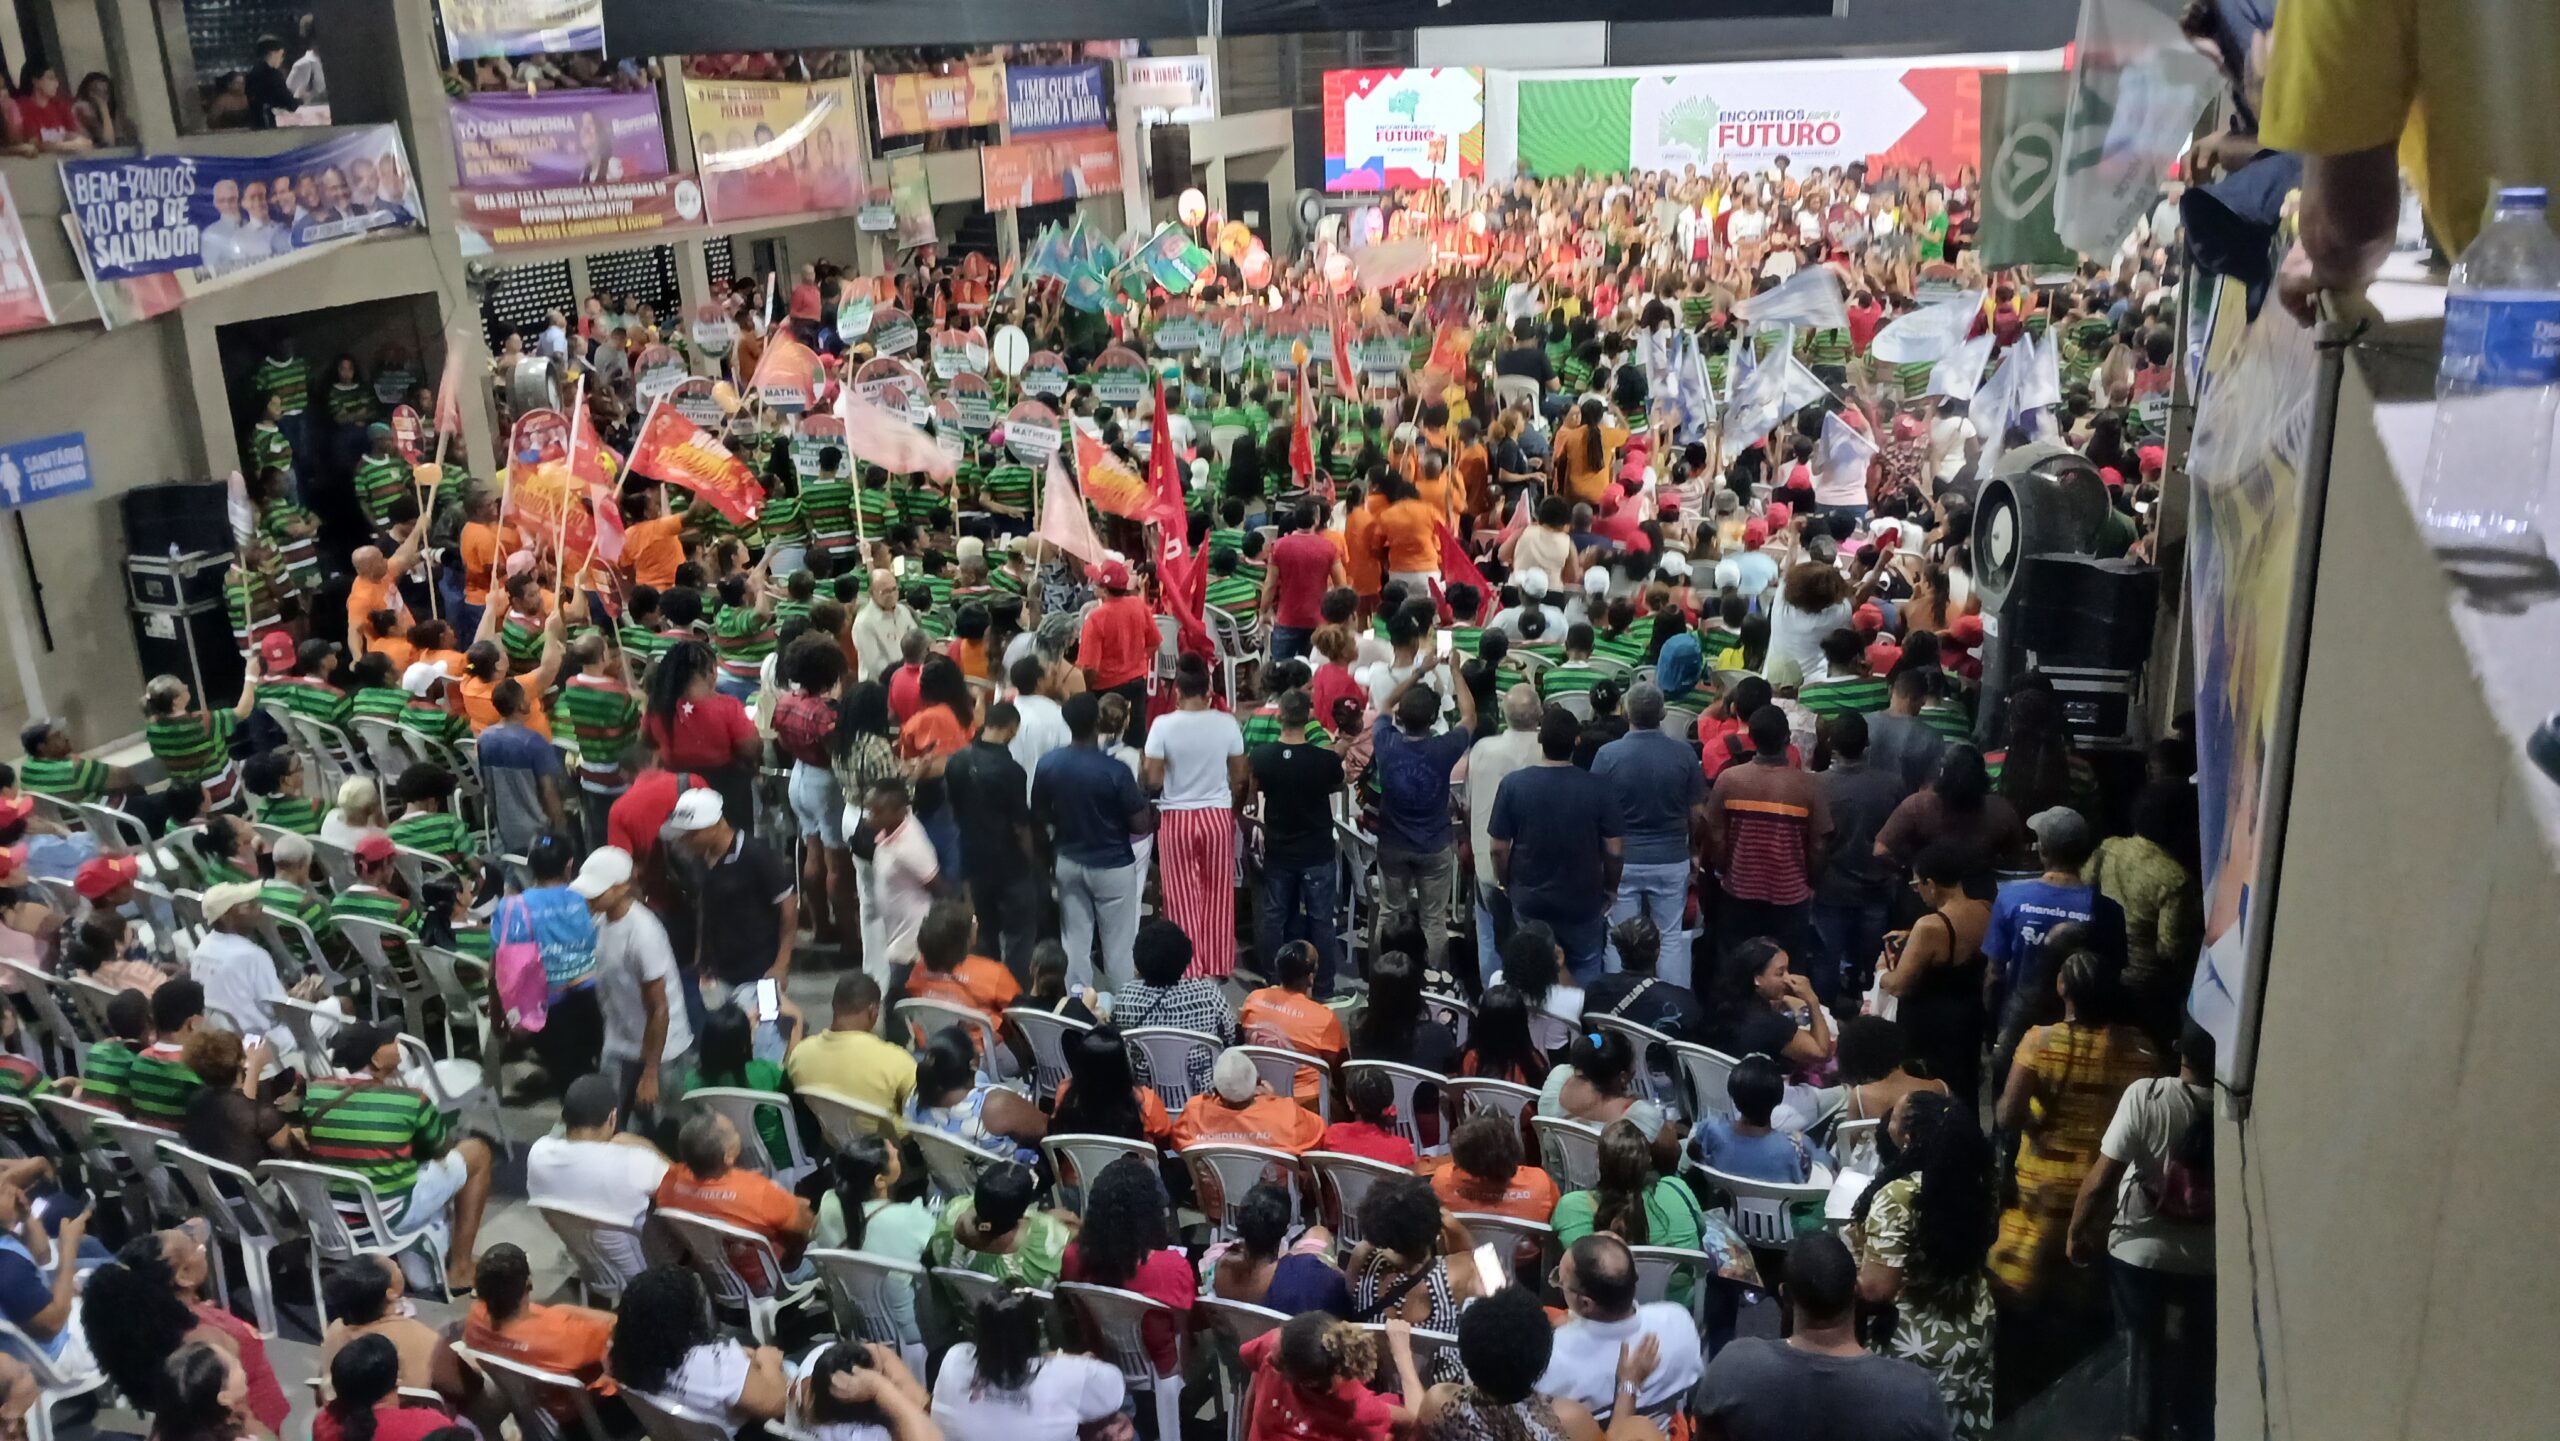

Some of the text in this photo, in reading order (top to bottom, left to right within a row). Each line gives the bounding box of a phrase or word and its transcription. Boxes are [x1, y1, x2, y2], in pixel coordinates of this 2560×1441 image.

[1017, 78, 1046, 101] TIME
[1049, 76, 1073, 100] QUE
[1011, 95, 1100, 128] MUDANDO A BAHIA
[1719, 109, 1805, 122] ENCONTROS
[479, 119, 511, 138] COM
[1376, 130, 1435, 142] FUTURO
[1719, 121, 1842, 149] FUTURO
[75, 165, 196, 205] BEM-VINDOS
[86, 197, 189, 238] AO PGP DE
[94, 225, 199, 268] SALVADOR
[765, 388, 807, 397] MATHE
[1012, 427, 1056, 442] MATHEUS
[23, 445, 84, 473] SANITÁRIO
[30, 464, 86, 491] FEMININO
[2068, 911, 2091, 922] aqu
